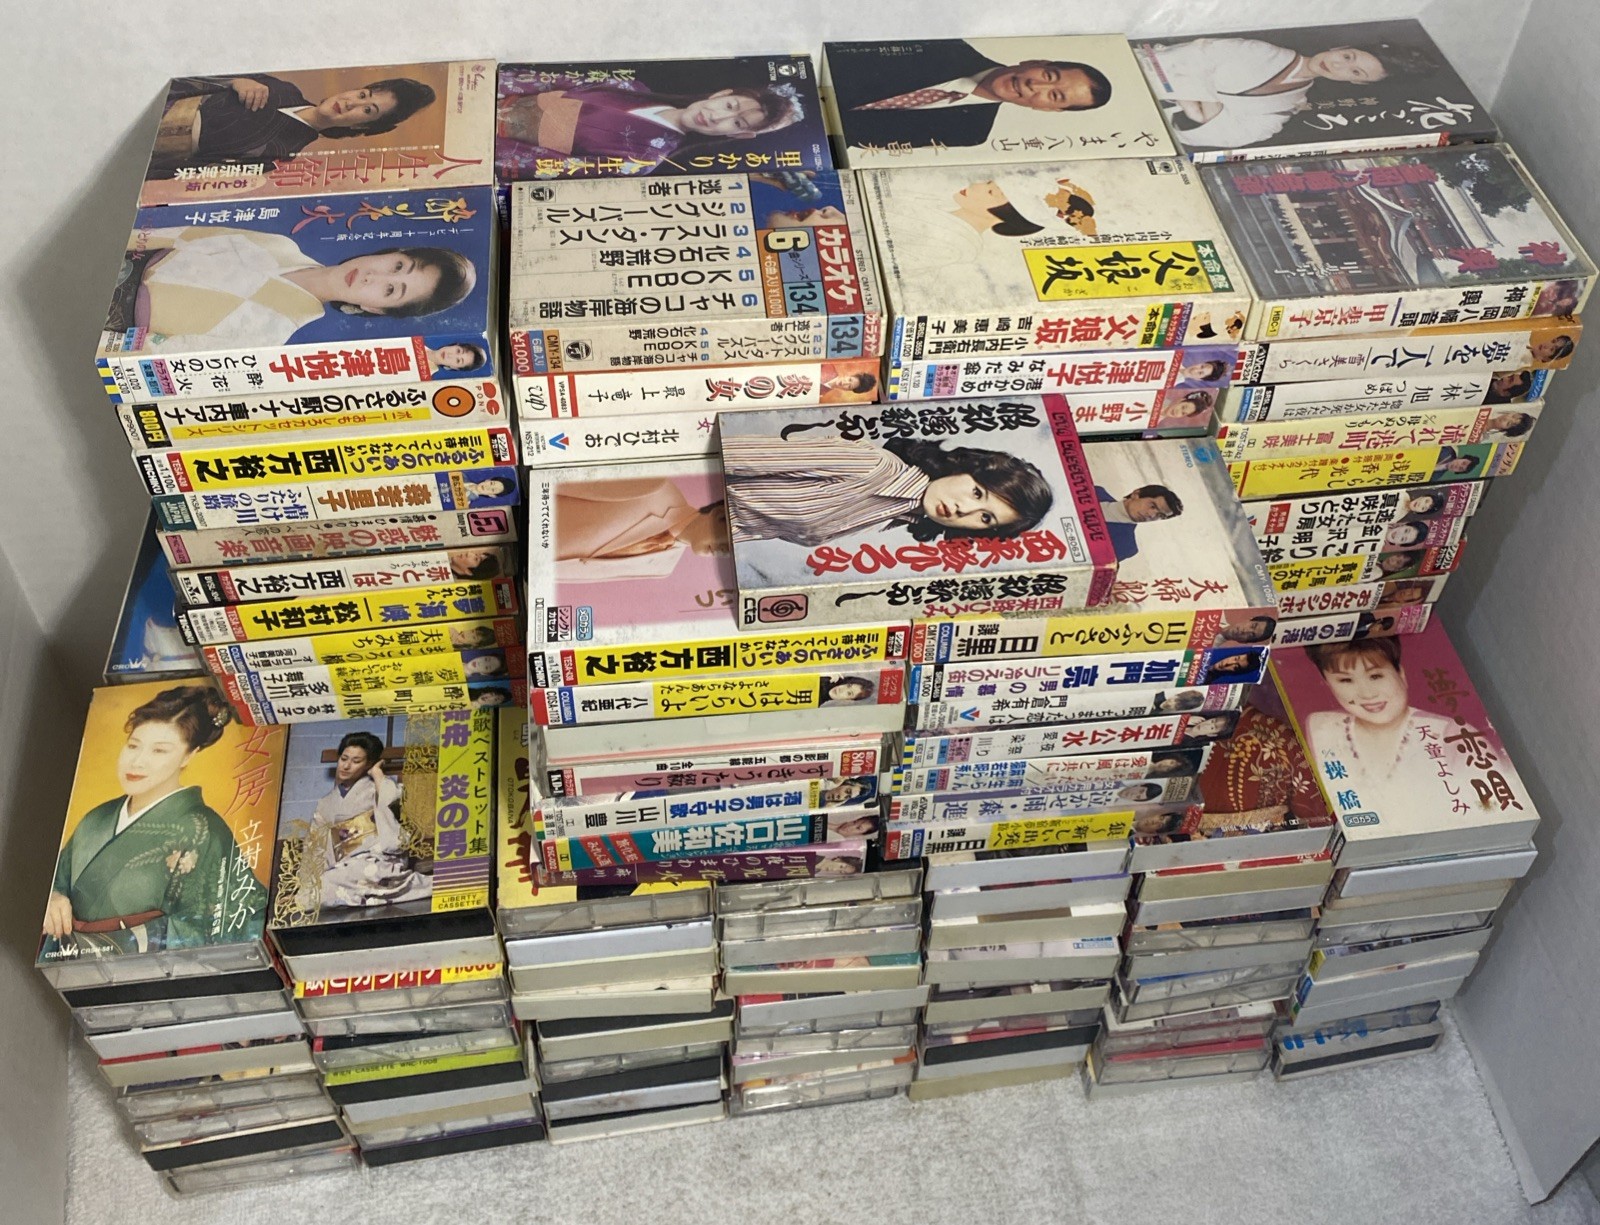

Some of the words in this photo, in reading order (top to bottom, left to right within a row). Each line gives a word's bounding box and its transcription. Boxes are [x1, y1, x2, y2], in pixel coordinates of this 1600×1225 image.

[513, 69, 636, 85] 杉森かおり
[857, 138, 948, 158] 千昌夫
[648, 179, 723, 197] 逃亡者
[185, 207, 281, 226] 島津悦子
[546, 200, 726, 224] ジグソーパズル
[731, 203, 746, 215] 2
[559, 223, 728, 246] ラスト・ダンス
[733, 225, 749, 237] 3
[599, 245, 731, 267] 化石の荒野
[736, 246, 752, 259] 4
[856, 249, 868, 272] STEREO
[627, 269, 733, 289] KOBE
[738, 269, 755, 282] 5
[816, 228, 859, 306] カラオケ
[1042, 250, 1200, 295] 父娘坂
[1196, 243, 1231, 291] 本命盤
[742, 293, 758, 307] 6
[787, 282, 822, 314] 134
[861, 276, 875, 306] CMY-134
[1455, 286, 1529, 307] 神輿
[539, 291, 737, 319] チャコの海岸物語
[1289, 303, 1388, 329] 甲斐京子
[1398, 304, 1522, 328] 富岡八幡音頭
[628, 326, 698, 341] 化石の荒野
[770, 320, 811, 333] 逃亡者
[830, 316, 860, 353] 134
[864, 314, 878, 352] カラオケ
[931, 316, 1033, 335] 吉崎恵美子
[1034, 314, 1140, 345] 父娘坂
[1140, 307, 1160, 345] 本命盤
[1270, 310, 1283, 335] HBC-1
[643, 340, 698, 352] KOBE
[716, 333, 811, 349] ジグソーパズル
[901, 320, 916, 358] 定価¥1,020
[928, 336, 1029, 355] 小山内長右衛門
[169, 354, 258, 373] ひとりの女
[512, 332, 530, 373] ¥1,000
[532, 338, 546, 367] 6曲入り
[546, 334, 562, 369] CMY-134
[609, 352, 699, 367] チャコの海岸物語
[1278, 353, 1365, 370] 雪美さくら
[1371, 341, 1512, 368] 夢を二人で
[269, 347, 411, 383] 島津悦子
[962, 359, 1047, 375] なみだ傘
[1046, 359, 1167, 387] 島津悦子
[1242, 349, 1256, 381] PRTS-234
[175, 373, 265, 392] 酔花火
[587, 386, 686, 403] 最上竜子
[706, 374, 813, 402] 炎の女
[959, 377, 1043, 394] 港のかもめ
[1363, 380, 1408, 397] つばめ
[1410, 382, 1484, 404] 小林旭
[164, 388, 427, 425] ふるさとの駅アナ・車内アナ
[475, 385, 486, 414] PONY
[137, 410, 164, 444] 800円
[1345, 414, 1423, 430] 母のぬくもり
[342, 434, 483, 458] 三年待っててくれないか
[584, 429, 680, 449] 北村ひでお
[1262, 431, 1335, 449] 富士美咲
[1338, 424, 1471, 450] 流れて港町
[192, 448, 342, 484] 西方裕之
[348, 448, 485, 475] ふるさとのあいつ
[1179, 444, 1194, 468] STEREO
[141, 458, 161, 495] TEICHIKU
[1299, 460, 1413, 481] 浅香光代
[201, 488, 303, 510] ふたりの旅路
[316, 484, 433, 513] 森若里子
[1301, 493, 1400, 516] 真咲みどり
[167, 502, 185, 525] JAPAN
[233, 503, 310, 525] 情け川
[1079, 510, 1106, 541] TAPE
[1295, 509, 1396, 531] 逃げた女房
[214, 524, 442, 558] 魅惑の映画音楽
[1258, 523, 1384, 548] 金沢明子
[1260, 538, 1381, 564] にごり絵
[234, 570, 345, 597] 西方裕之
[351, 566, 452, 588] 赤とんぼ
[183, 577, 200, 604] BMG
[426, 584, 483, 600] 縄のれん
[1110, 577, 1229, 604] 夫婦船
[252, 602, 360, 632] 松村和子
[378, 597, 486, 623] 夢海峡
[547, 611, 558, 641] カセット
[558, 607, 571, 639] シングル
[954, 624, 999, 638] 譲二
[1050, 618, 1189, 647] 山のふるさと
[1191, 617, 1206, 645] カセット
[1200, 614, 1220, 647] シングル
[351, 629, 444, 650] 夫婦みち
[739, 632, 880, 654] 三年待っててくれないか
[893, 631, 905, 657] シングル
[912, 629, 924, 660] ¥1,000
[925, 624, 939, 662] CMY-1080
[938, 624, 951, 660] COLUMBIA
[956, 635, 1039, 658] 目黒
[584, 645, 732, 680] 西方裕之
[740, 644, 879, 669] ふるさとのあいつ
[262, 671, 304, 684] 舞子
[339, 668, 458, 692] 夢織り酒場
[532, 654, 547, 688] TEICHIKU
[947, 666, 1063, 682] リラ冷えの街
[1062, 660, 1181, 689] 加門亮
[267, 681, 330, 700] 多岐川
[659, 678, 770, 696] さよならあんた
[920, 674, 934, 698] ¥1,000
[944, 680, 1060, 699] 男の慕情
[276, 703, 336, 717] 林るり子
[560, 690, 573, 723] COLUMBIA
[579, 696, 649, 713] 八代亜紀
[661, 688, 814, 714] 男はつらいよ
[990, 694, 1069, 712] 門倉有希
[1062, 724, 1173, 749] 岩本公水
[222, 727, 282, 816] 女房
[655, 760, 694, 772] 全10曲
[1046, 756, 1148, 775] 愛は風と共に
[1415, 725, 1471, 816] 天童よしみ
[1323, 759, 1362, 811] 操橋
[667, 791, 803, 819] 酒は男の子守歌
[583, 806, 661, 829] 山川豊
[651, 818, 807, 855] 山口佐和美
[925, 839, 986, 855] 目黒
[655, 853, 808, 870] 月夜のひまわり
[227, 819, 265, 934] 立樹みか
[437, 900, 482, 910] CASSETTE
[355, 1061, 395, 1074] CASSETTE
